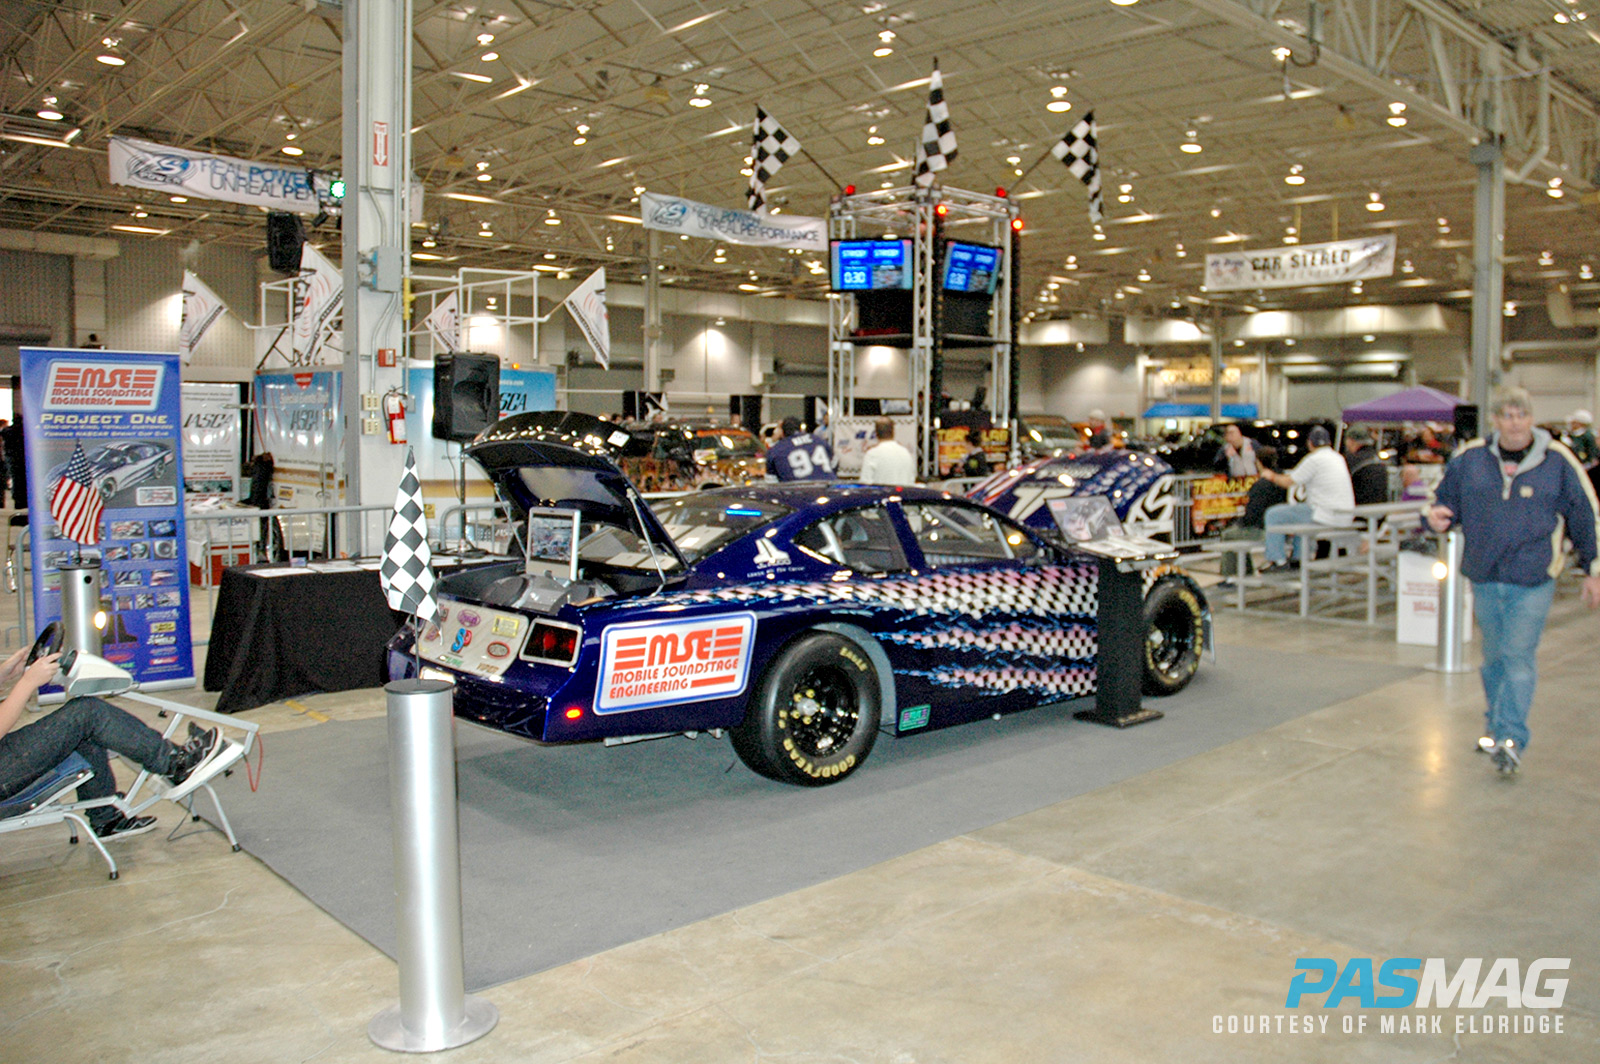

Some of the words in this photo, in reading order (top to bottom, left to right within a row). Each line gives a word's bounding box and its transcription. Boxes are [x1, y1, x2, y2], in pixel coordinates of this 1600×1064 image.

[210, 173, 280, 198] UNREAL
[740, 222, 819, 242] PERFORMANCE
[1252, 256, 1281, 271] CAR
[1290, 249, 1350, 269] STEREO
[80, 367, 133, 389] MSE
[50, 397, 113, 406] ENGINEERING
[51, 388, 90, 397] MOBILE
[92, 389, 154, 398] SOUNDSTAGE
[787, 445, 832, 478] 94
[647, 629, 713, 667] MSE
[839, 646, 868, 672] EAGLE
[611, 667, 660, 685] MOBILE
[662, 658, 739, 678] SOUNDSTAGE
[609, 678, 688, 699] ENGINEERING
[783, 737, 856, 779] GOODYEAR
